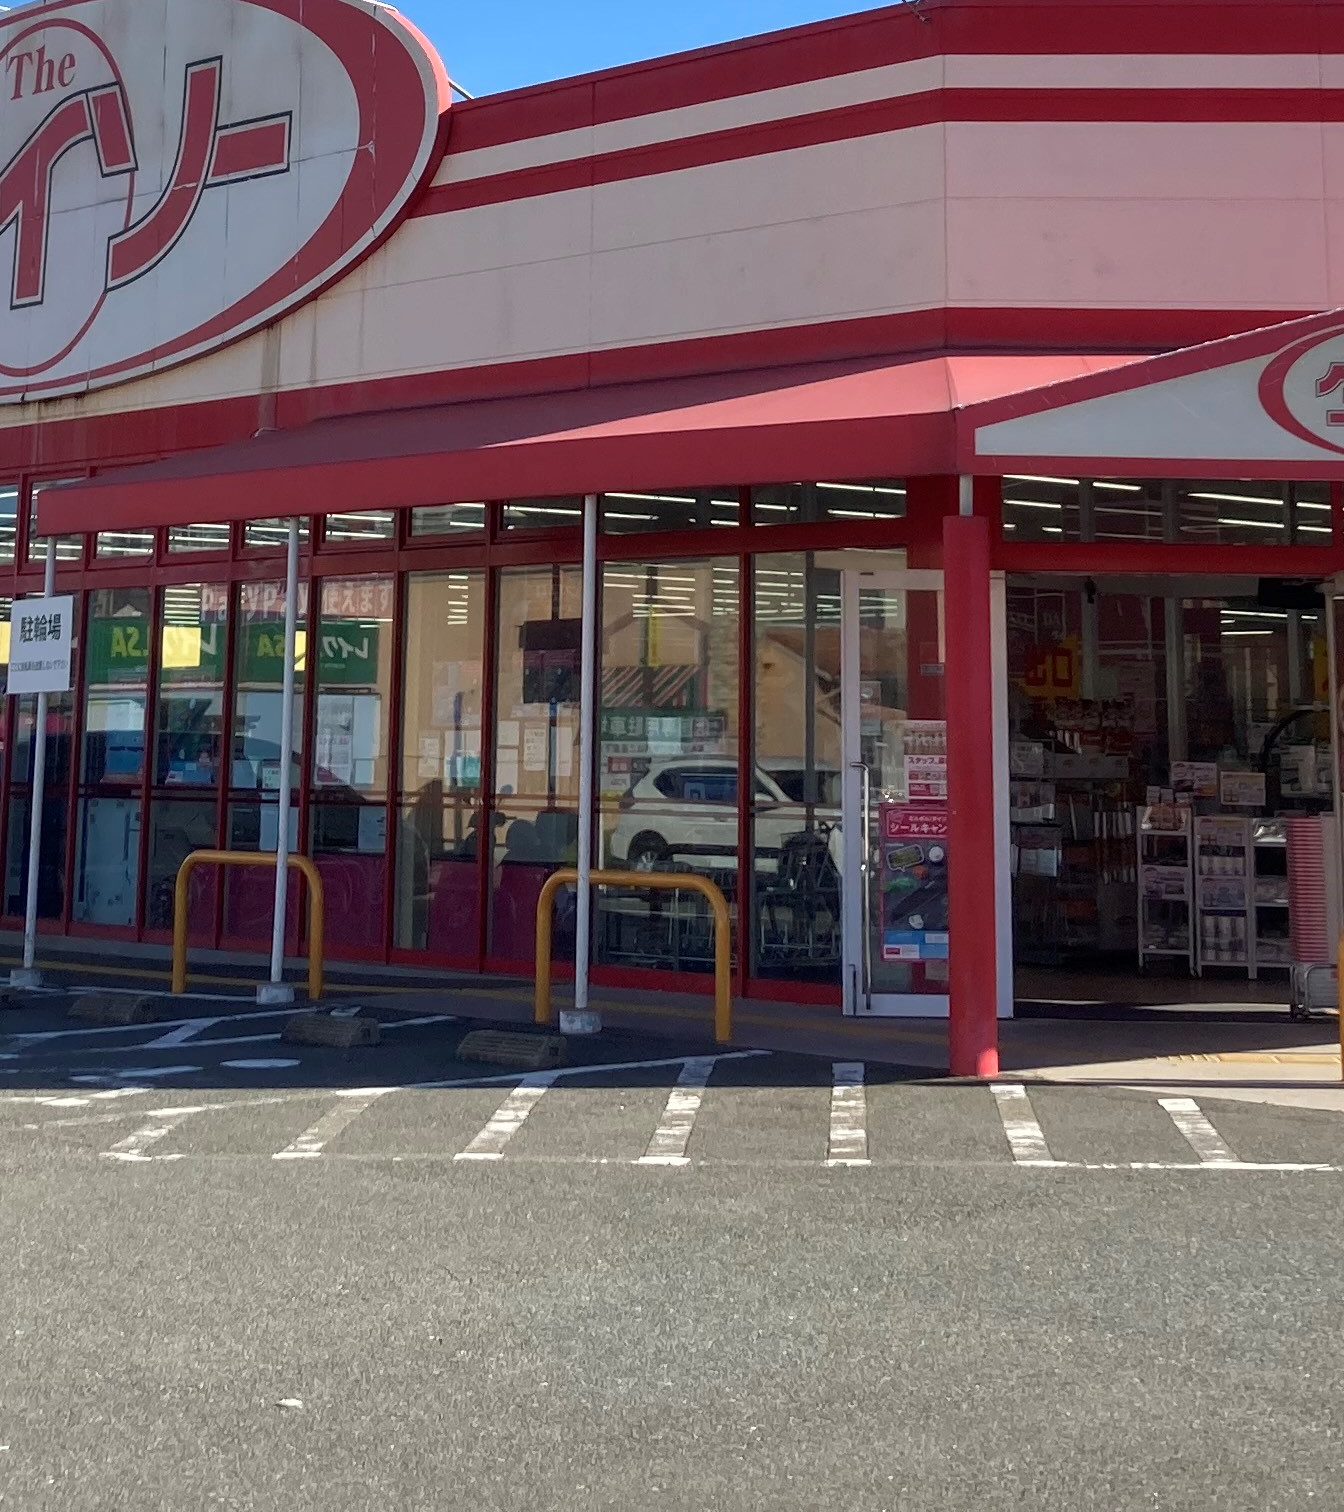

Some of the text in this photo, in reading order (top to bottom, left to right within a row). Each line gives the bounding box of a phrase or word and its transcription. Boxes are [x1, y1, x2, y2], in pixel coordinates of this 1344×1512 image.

[6, 45, 76, 101] The
[19, 613, 62, 643] 駐輪場
